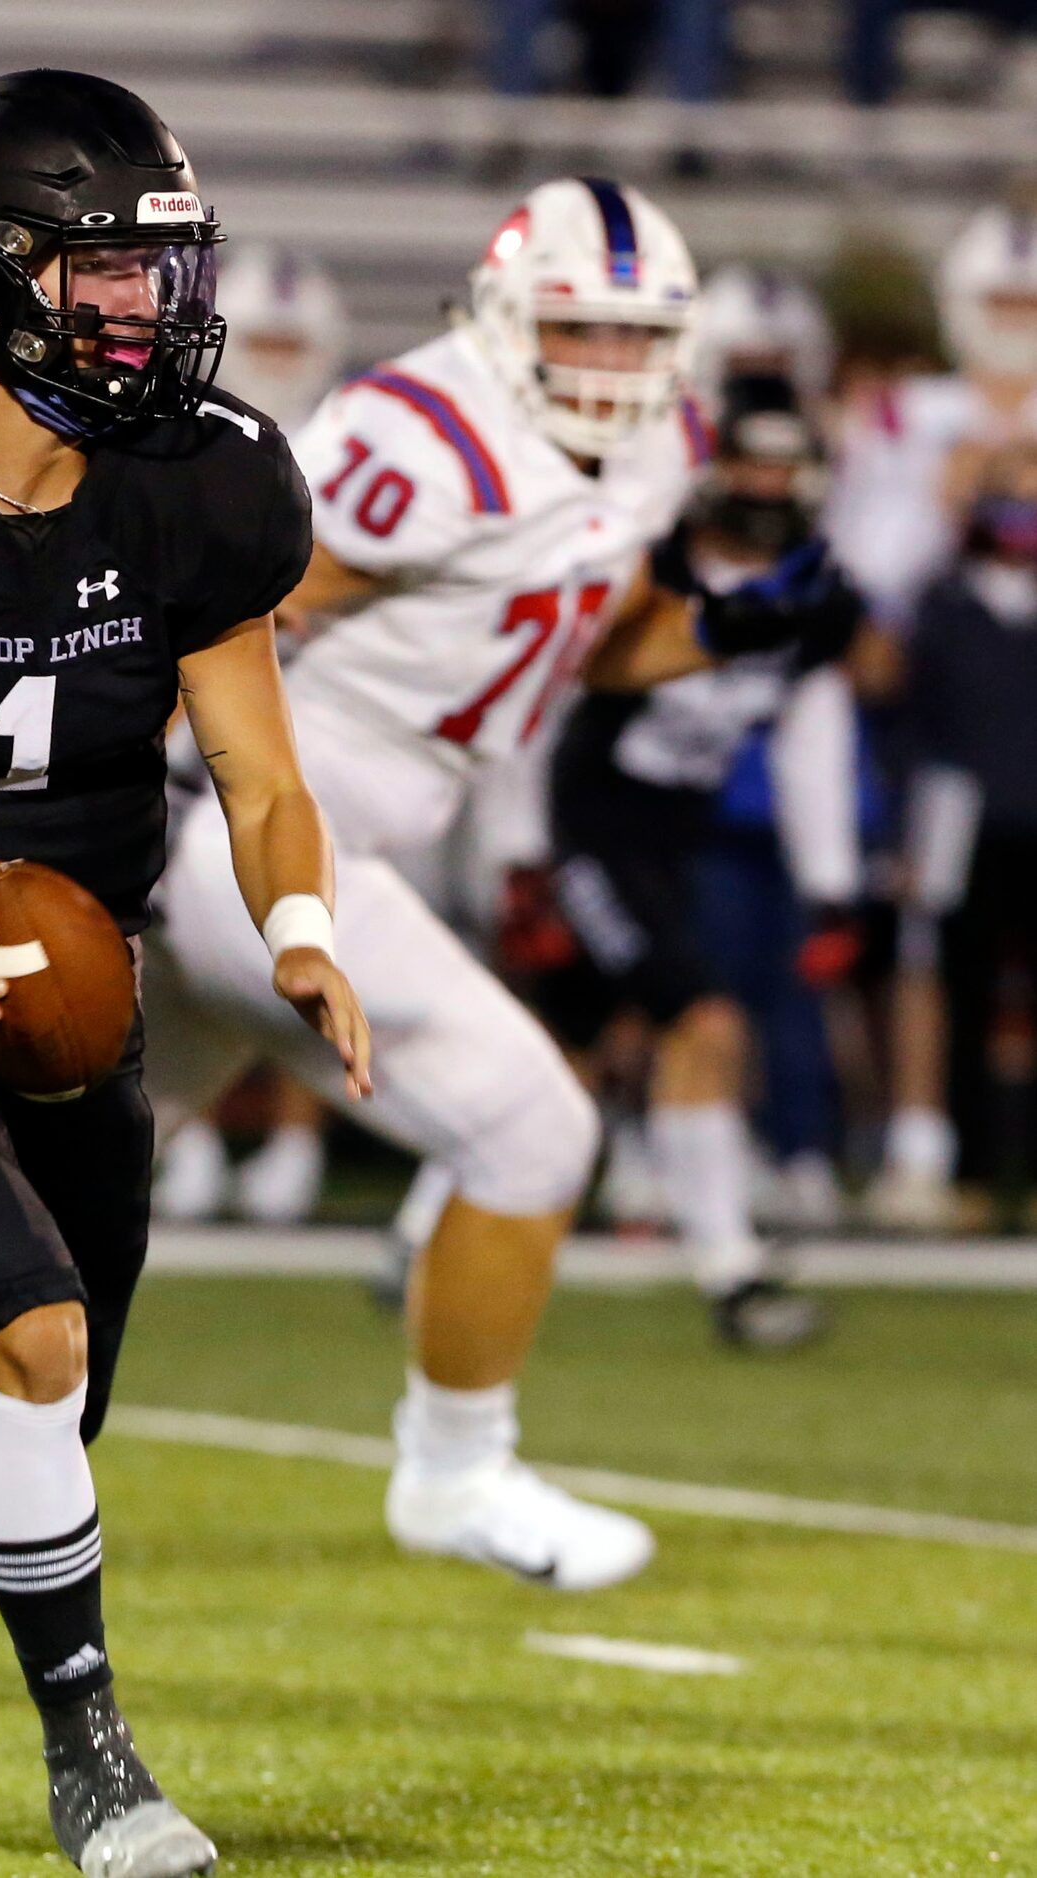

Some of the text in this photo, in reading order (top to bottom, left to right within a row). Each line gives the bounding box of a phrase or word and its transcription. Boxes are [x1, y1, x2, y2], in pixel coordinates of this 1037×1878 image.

[149, 197, 199, 213] Riddell
[195, 400, 260, 442] 1
[321, 432, 416, 540] 70
[49, 616, 143, 663] LYNCH
